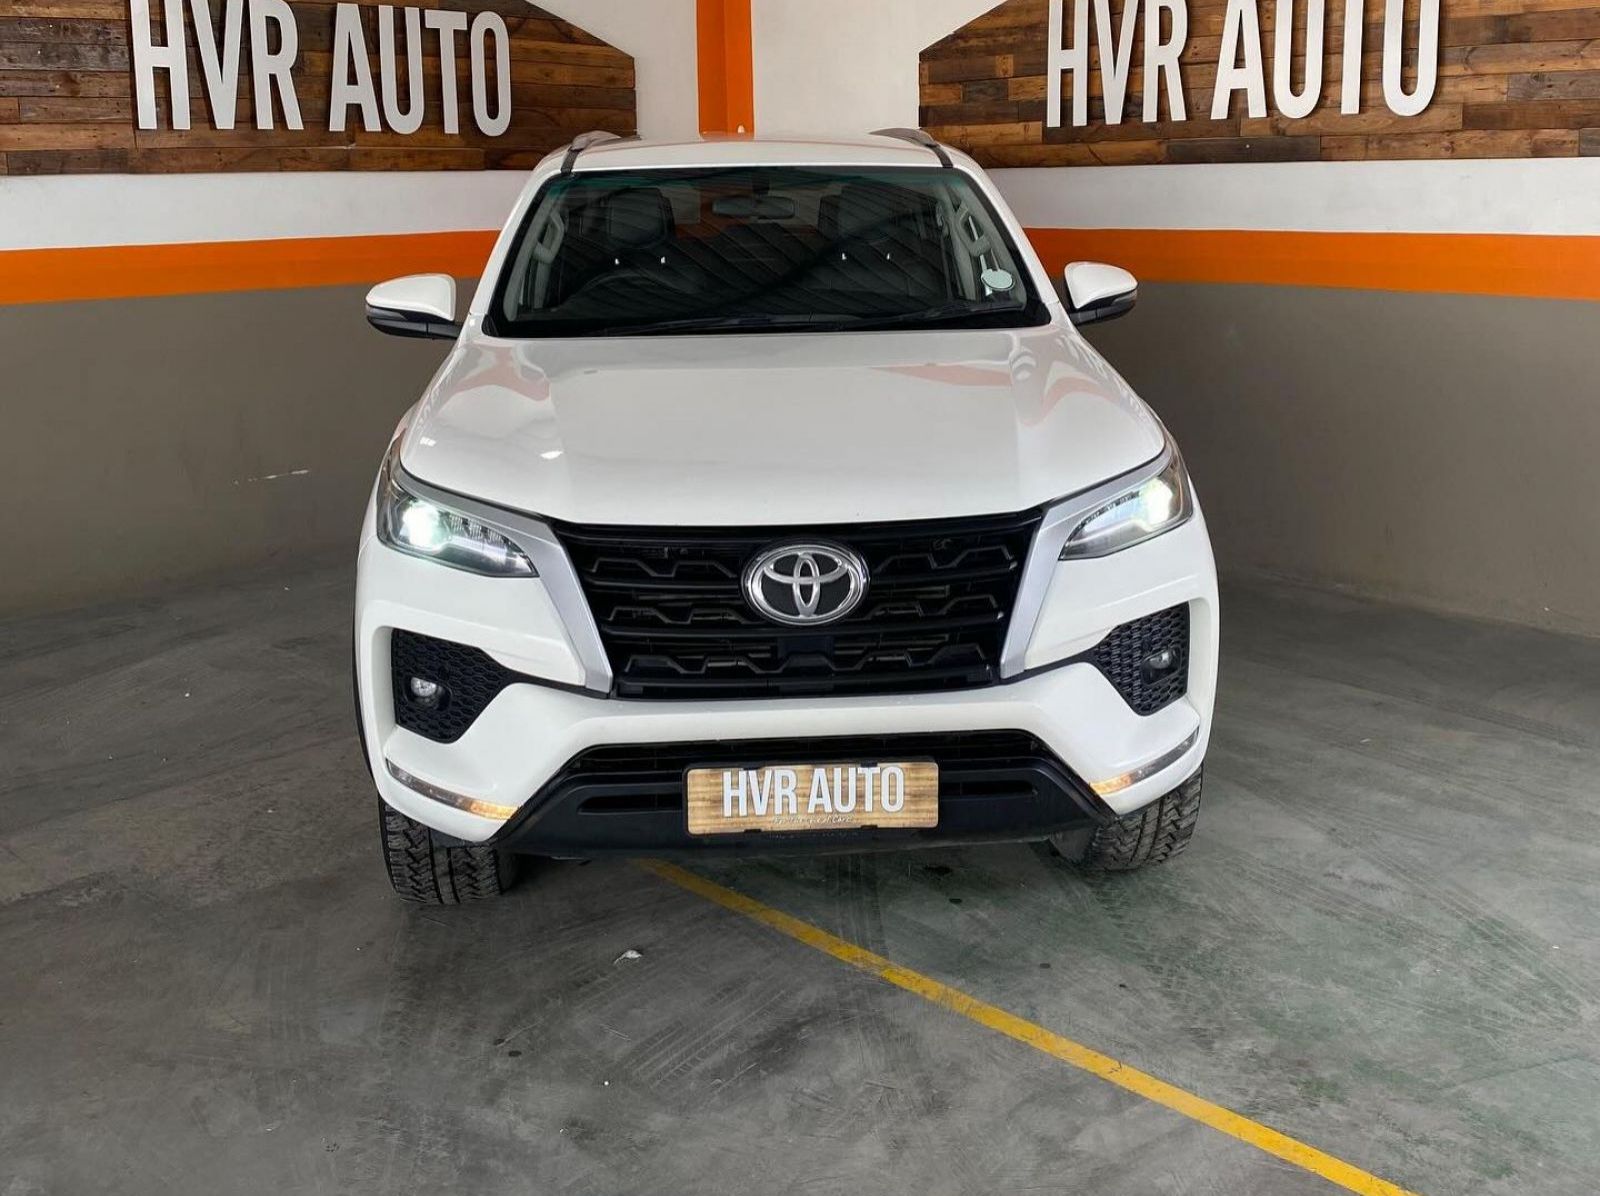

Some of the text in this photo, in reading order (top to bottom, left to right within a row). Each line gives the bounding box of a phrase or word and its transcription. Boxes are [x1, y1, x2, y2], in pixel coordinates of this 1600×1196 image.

[131, 0, 511, 137] HVR AUTO
[1047, 0, 1188, 127] HVR
[723, 766, 904, 817] HVR AUTO
